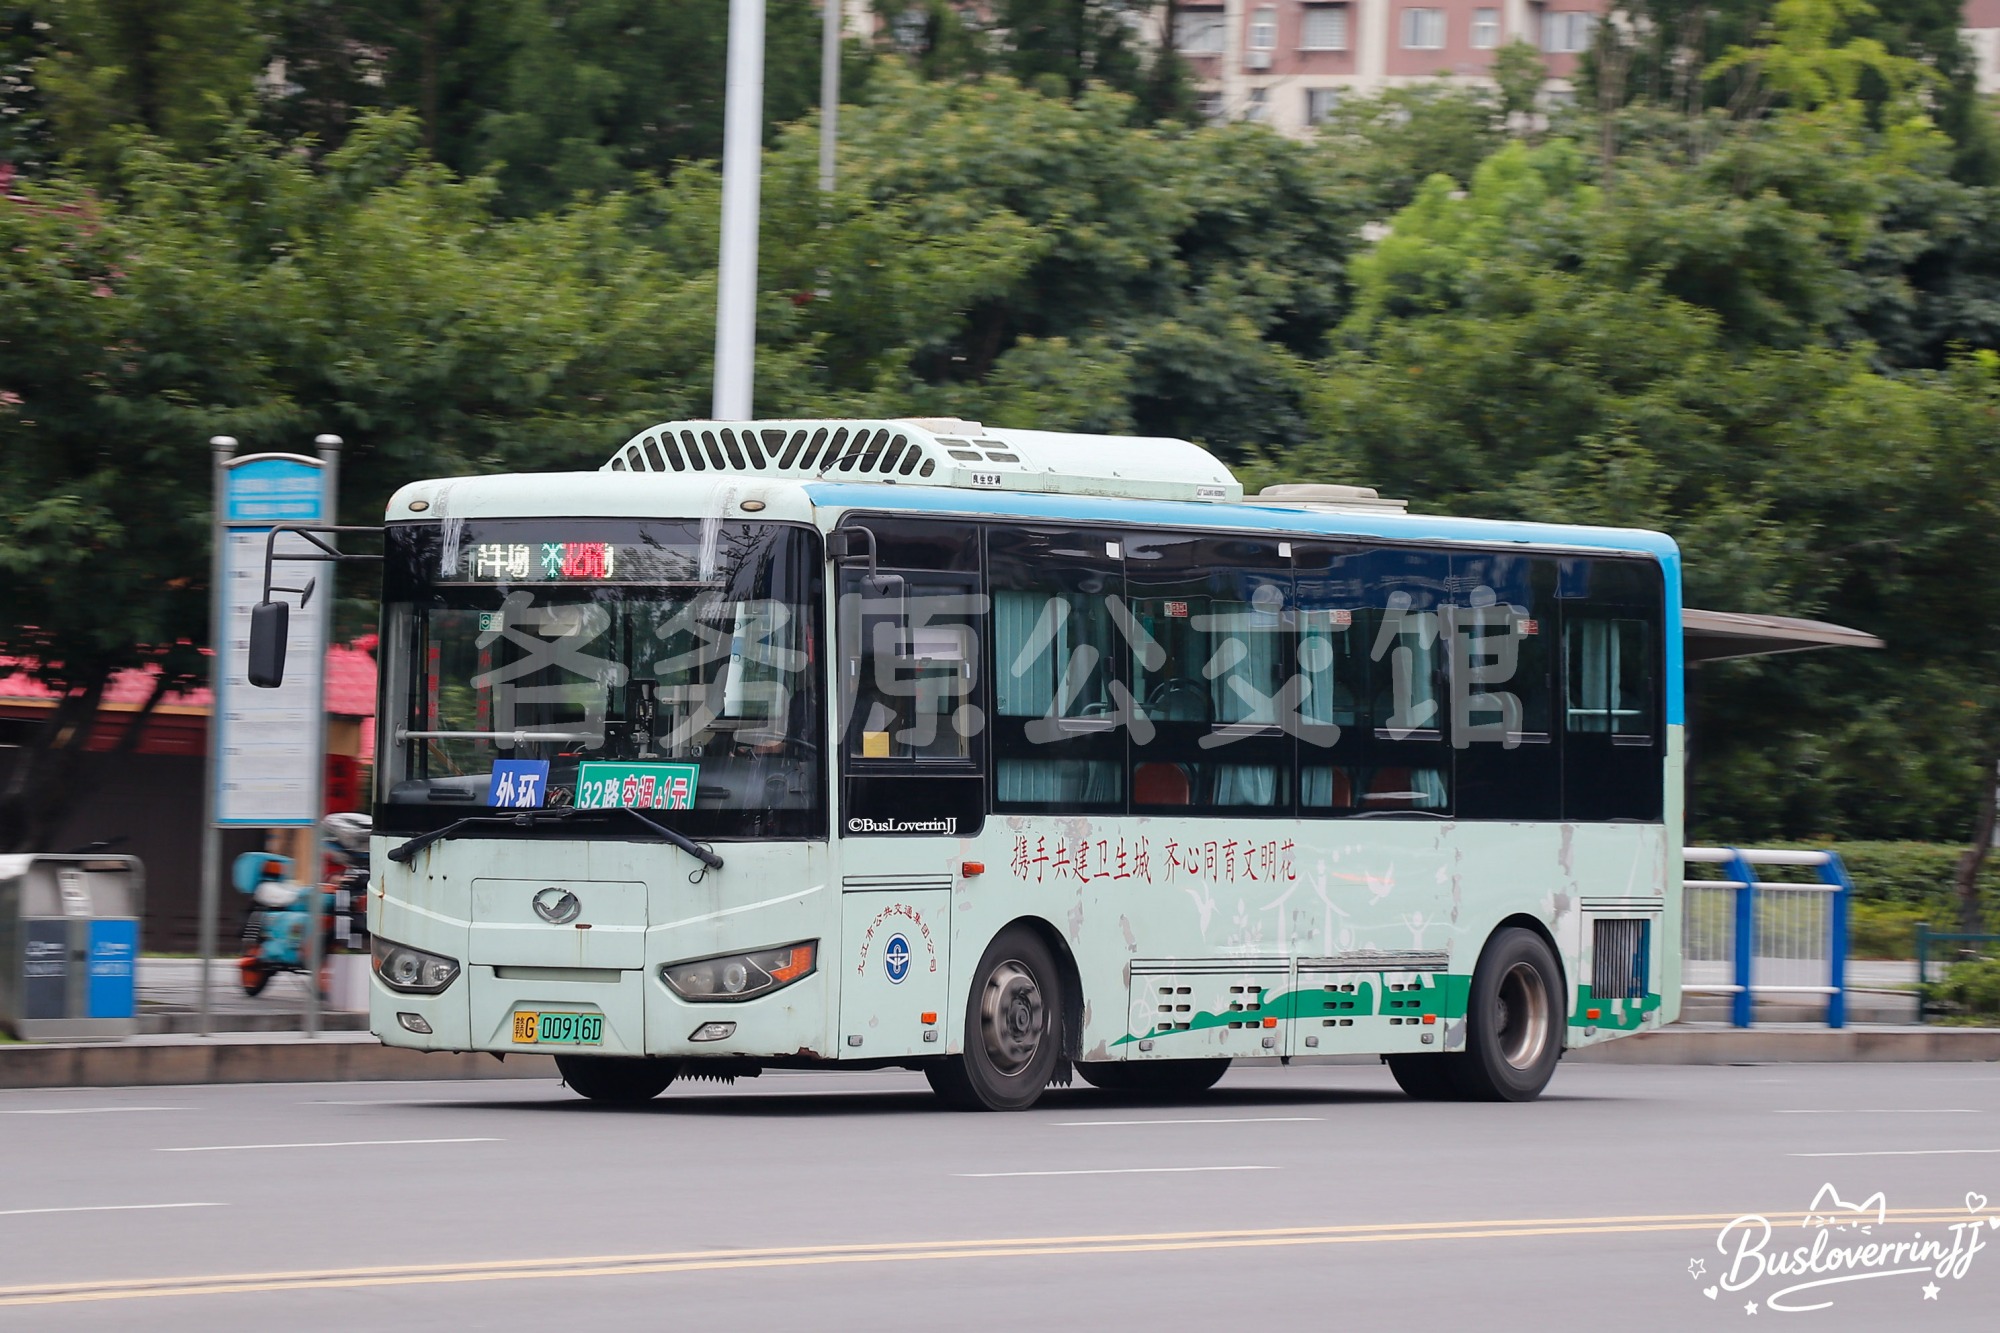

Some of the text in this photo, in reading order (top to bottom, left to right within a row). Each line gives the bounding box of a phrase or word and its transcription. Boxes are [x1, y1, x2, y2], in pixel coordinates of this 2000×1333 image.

[495, 771, 540, 808] 外环
[1010, 835, 1297, 885] 携手共建卫生城 齐心同育文明花
[857, 903, 937, 978] 九江市公共交通集团公司
